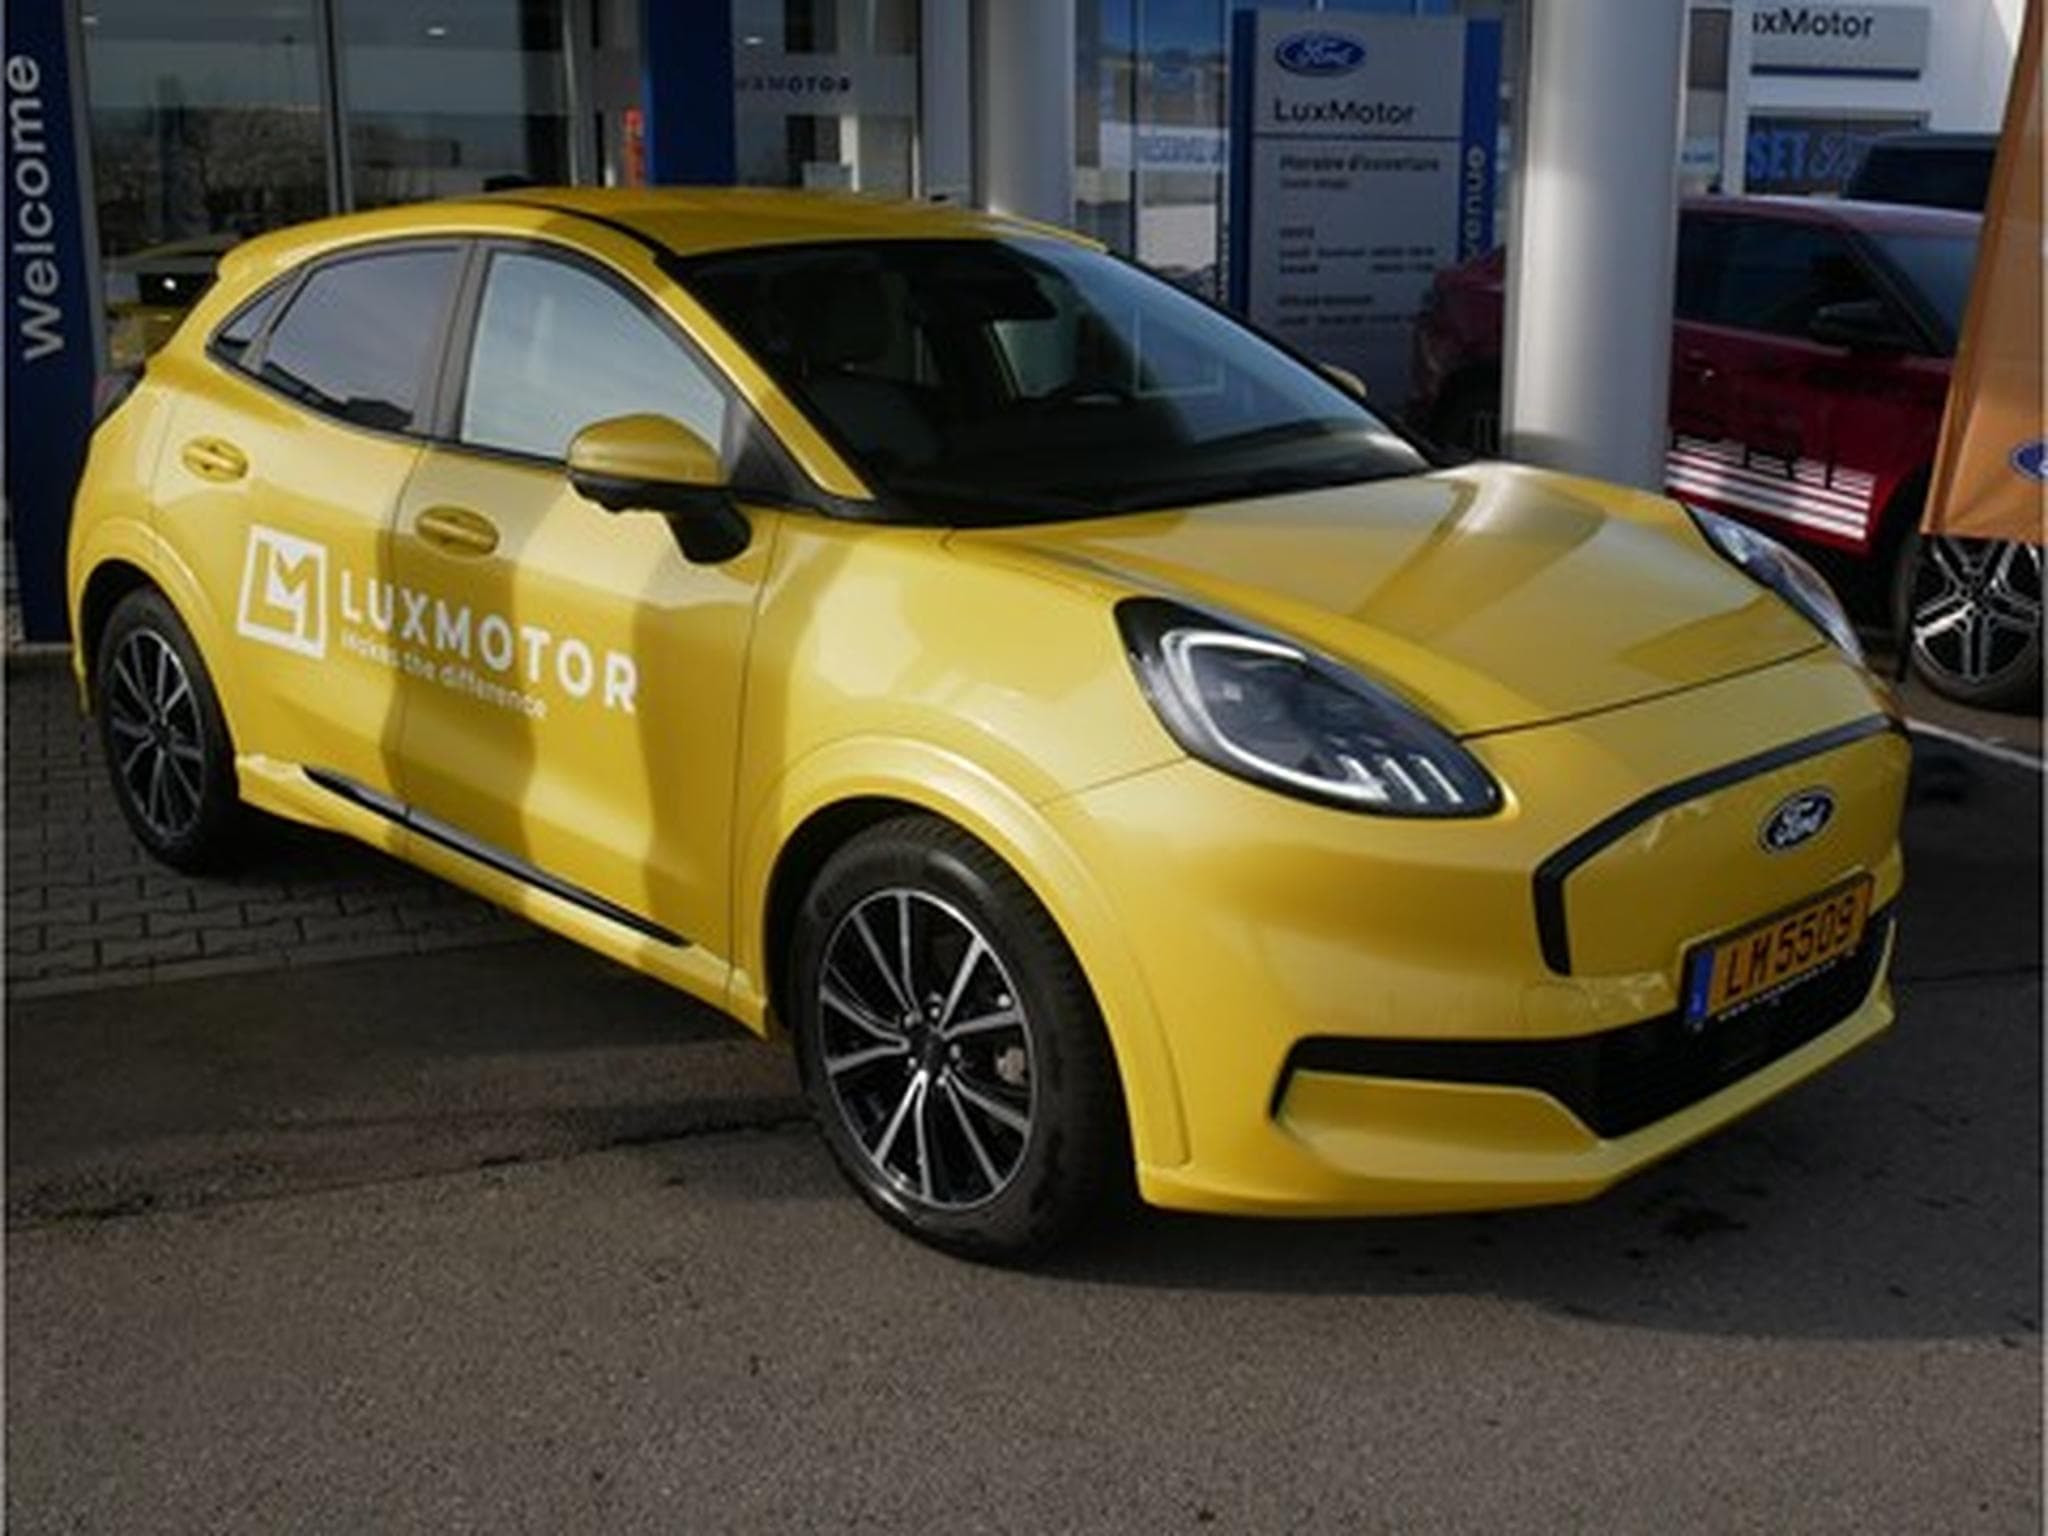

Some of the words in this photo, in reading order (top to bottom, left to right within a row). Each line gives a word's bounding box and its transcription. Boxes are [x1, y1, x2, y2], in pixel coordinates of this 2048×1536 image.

[1274, 98, 1415, 125] LuxMotor
[340, 569, 638, 713] LUXMOTOR
[402, 650, 437, 682] the
[439, 664, 549, 721] difference
[1768, 794, 1830, 846] Ford
